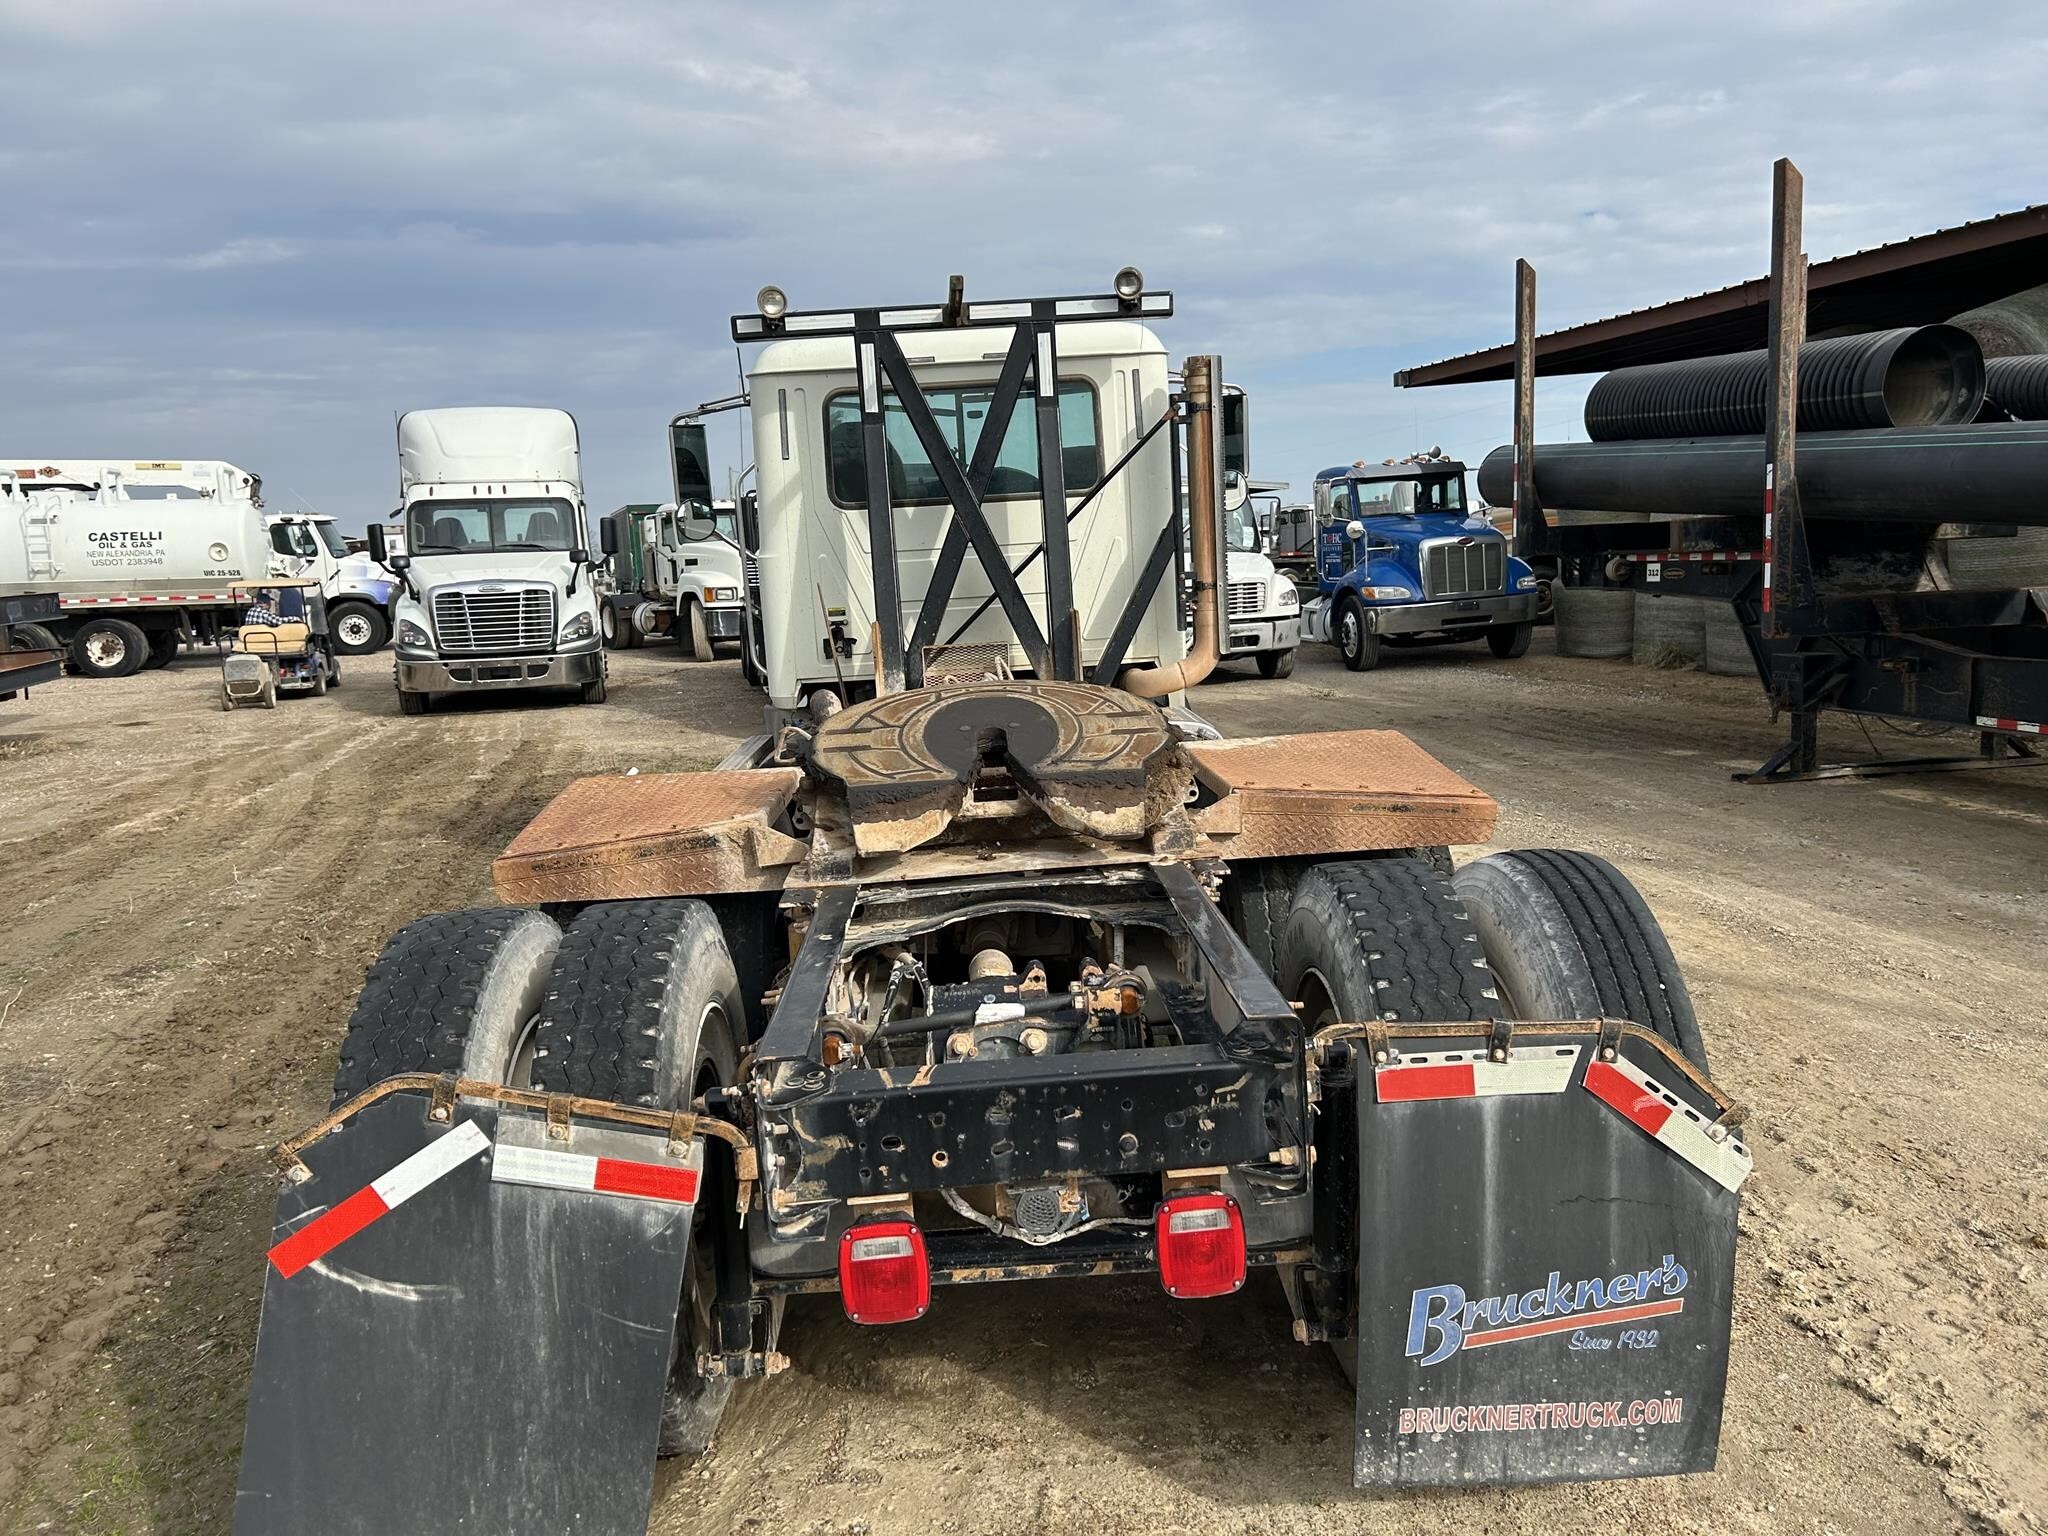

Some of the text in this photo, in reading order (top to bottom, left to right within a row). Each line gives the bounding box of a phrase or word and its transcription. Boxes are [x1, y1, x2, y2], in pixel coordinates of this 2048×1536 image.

[88, 531, 162, 542] CASTELLI
[1405, 1254, 1688, 1367] Bruckner's
[1400, 1398, 1683, 1433] BRUCKNERTRUCK.COM
